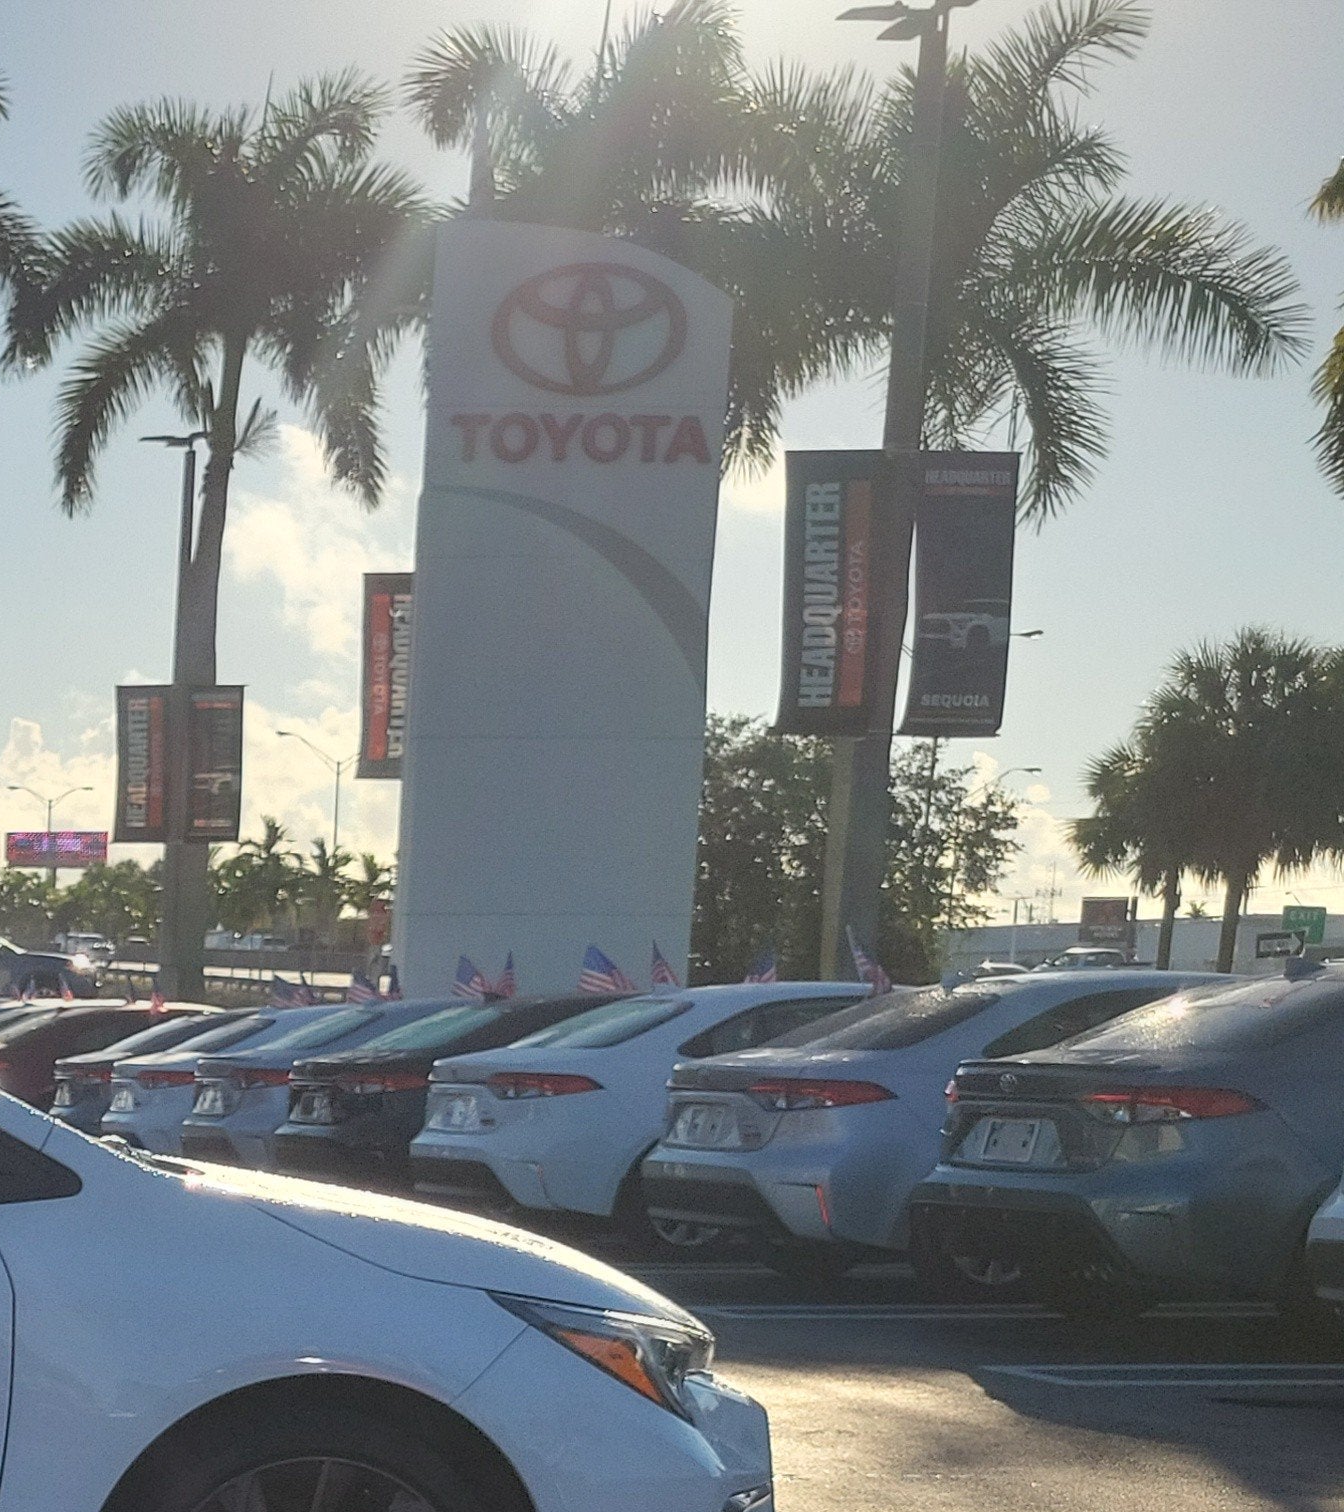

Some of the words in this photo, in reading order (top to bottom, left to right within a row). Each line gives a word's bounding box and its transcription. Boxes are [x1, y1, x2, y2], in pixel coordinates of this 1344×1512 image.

[450, 412, 713, 465] TOYOTA
[798, 481, 841, 707] HEADQUARTER
[845, 540, 865, 627] TOYOTA
[921, 693, 990, 707] SEQUOIA
[125, 698, 148, 828] HEADQUARTER
